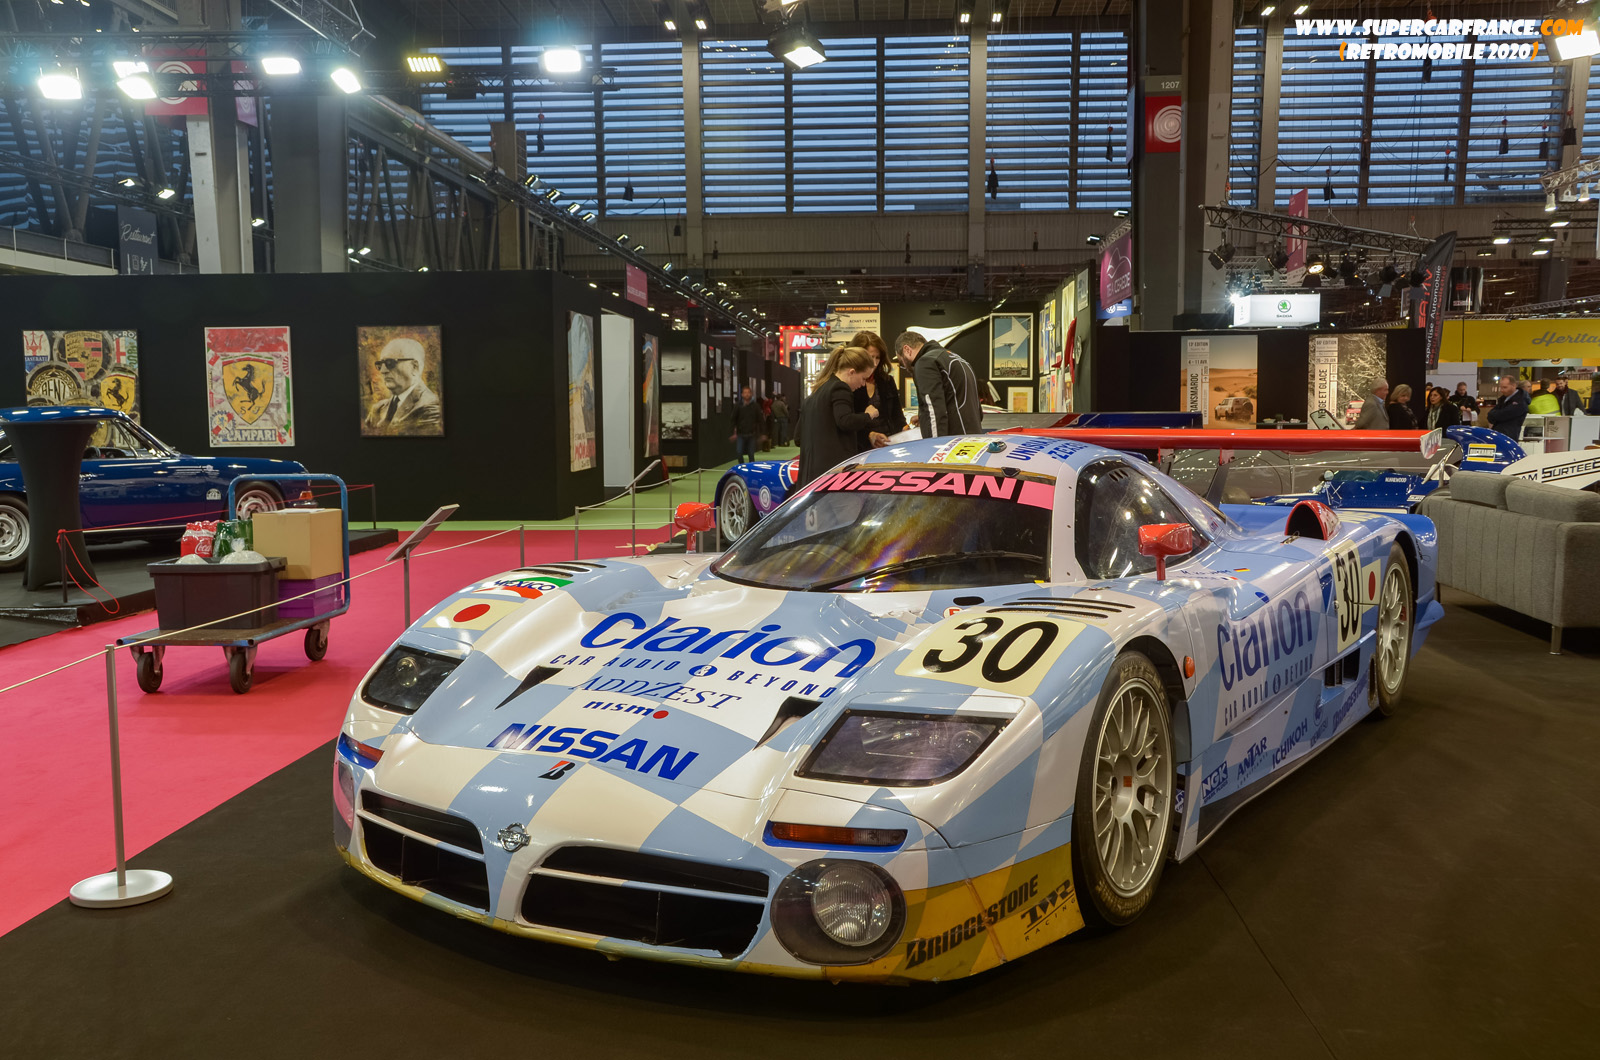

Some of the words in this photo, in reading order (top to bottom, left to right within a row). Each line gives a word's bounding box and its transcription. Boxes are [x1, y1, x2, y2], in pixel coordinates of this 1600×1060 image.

[1161, 81, 1179, 89] 1207
[1430, 265, 1441, 319] Automobile
[792, 335, 823, 347] MO
[1426, 322, 1435, 364] Expertise
[1190, 373, 1199, 413] RANSMAROC
[1319, 369, 1327, 389] GLACE
[226, 429, 277, 441] CAMPARI
[932, 452, 947, 461] 24
[815, 470, 1017, 500] NISSAN
[494, 580, 556, 591] MEXICO
[1334, 550, 1360, 642] 30
[580, 612, 876, 678] Clarion
[922, 617, 1059, 683] 30
[549, 654, 595, 666] CAR
[602, 657, 681, 670] AUDIO
[727, 670, 837, 698] BEYOND
[568, 676, 742, 710] ADDZEST
[486, 723, 699, 781] NISSAN
[1237, 737, 1267, 781] ANTAR
[1272, 718, 1308, 769] ICHIKOH
[1202, 762, 1228, 798] NGK
[905, 874, 1038, 970] BRIDGESTONE
[1024, 898, 1075, 943] RACING
